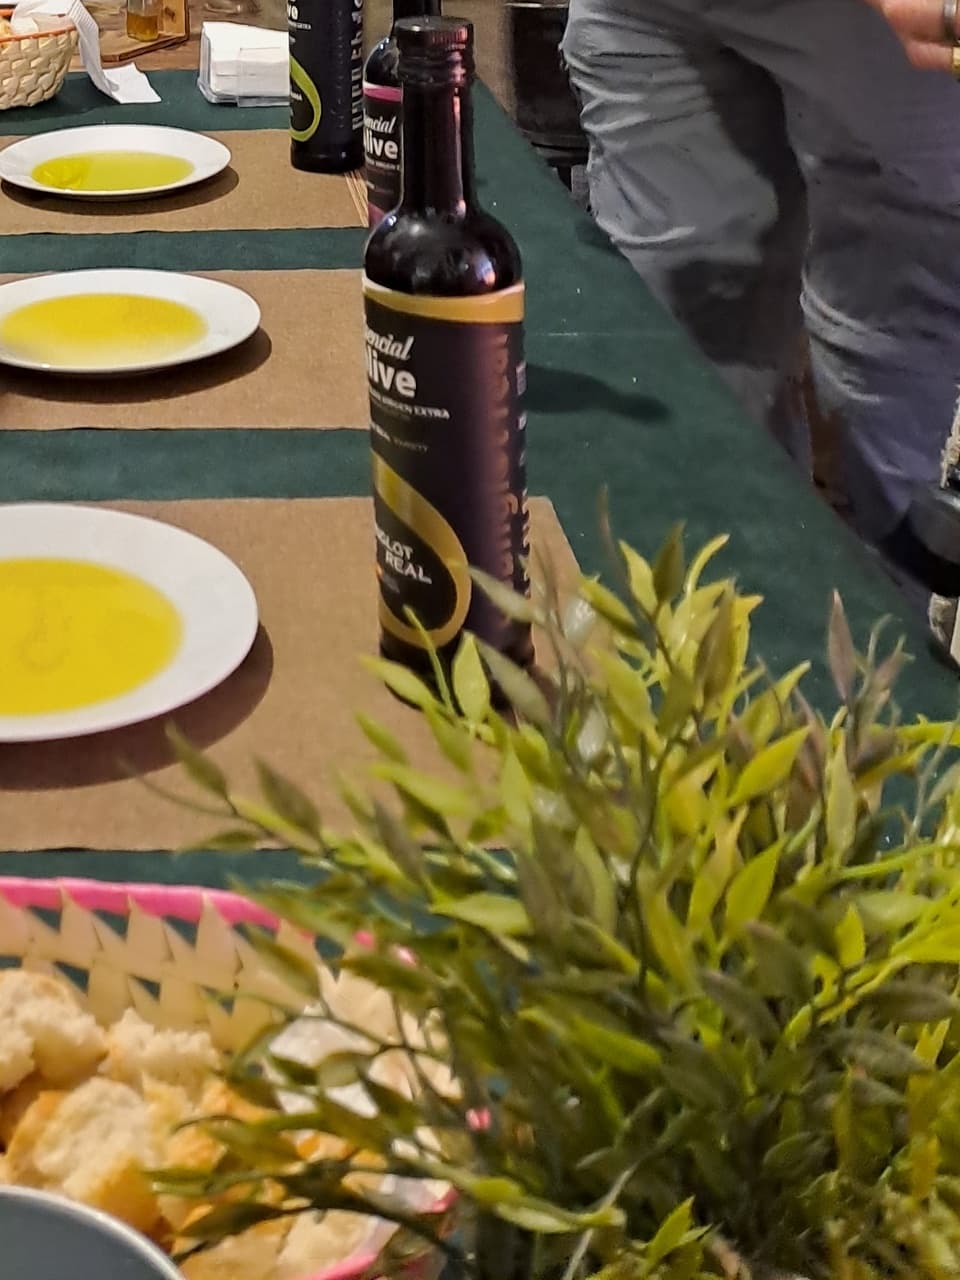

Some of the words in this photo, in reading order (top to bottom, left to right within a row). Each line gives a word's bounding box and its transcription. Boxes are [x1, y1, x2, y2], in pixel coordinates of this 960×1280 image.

[364, 126, 399, 160] live
[367, 344, 417, 398] live
[413, 405, 451, 420] EXTRA
[385, 549, 433, 585] REAL
